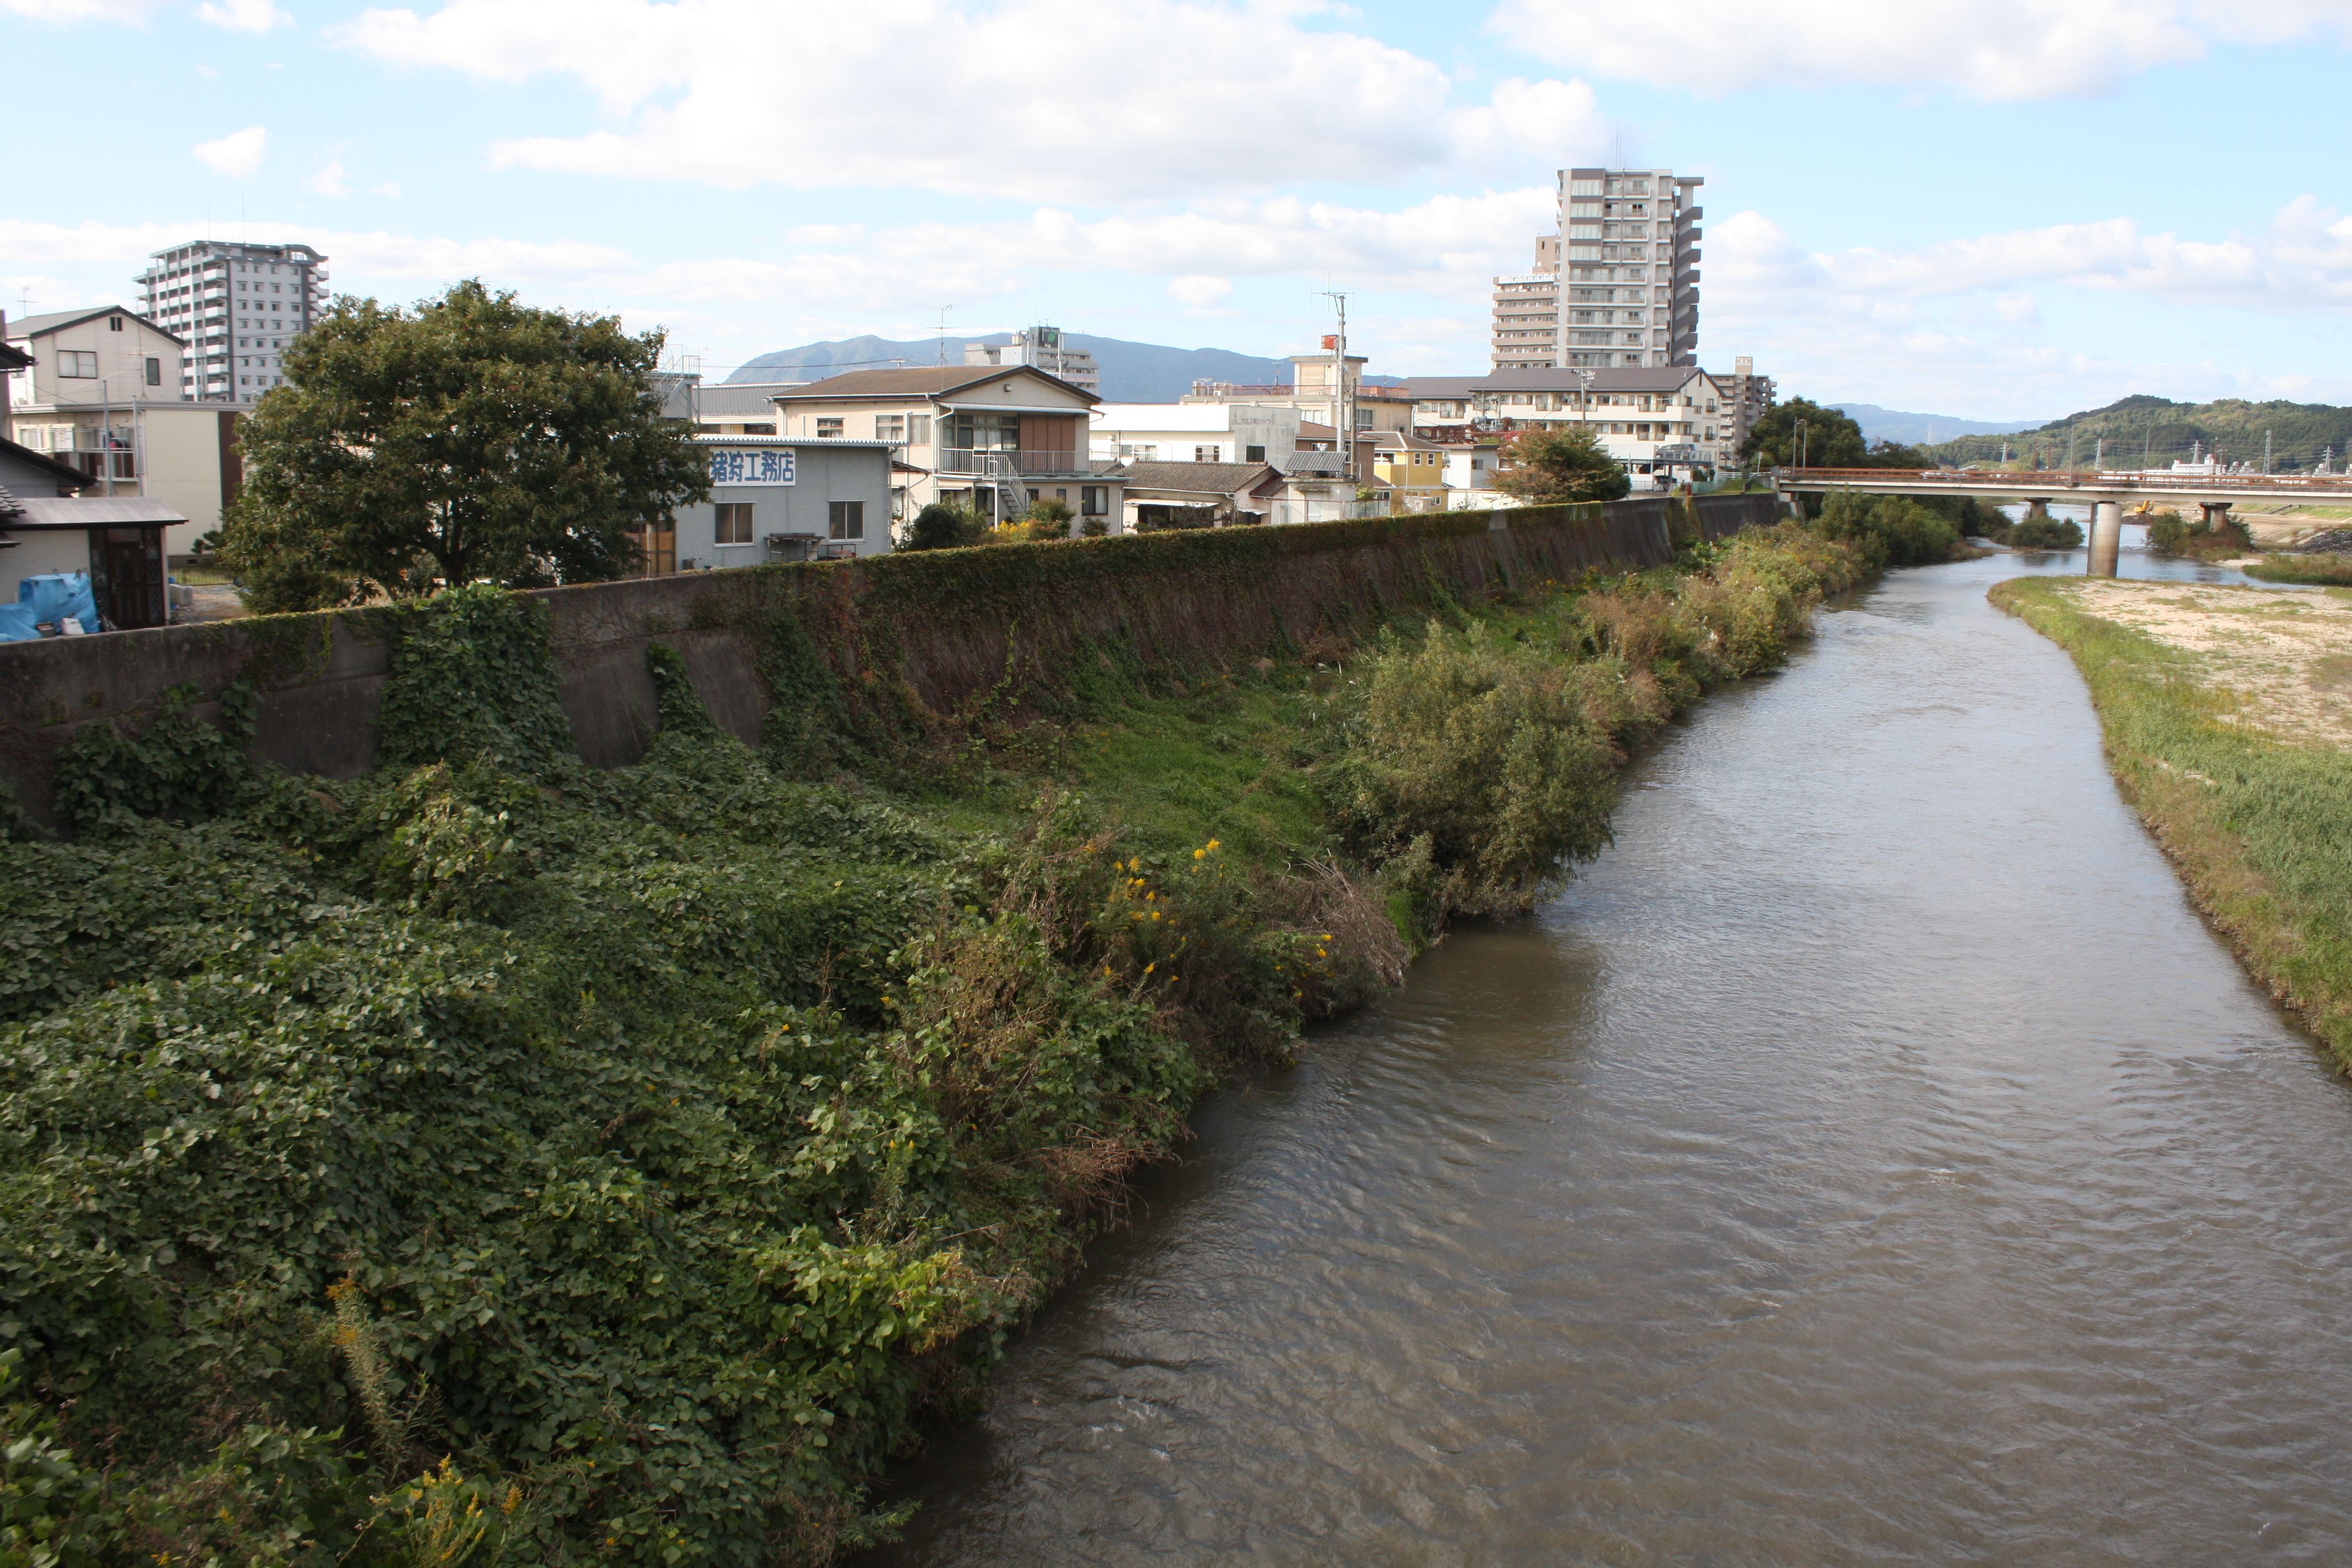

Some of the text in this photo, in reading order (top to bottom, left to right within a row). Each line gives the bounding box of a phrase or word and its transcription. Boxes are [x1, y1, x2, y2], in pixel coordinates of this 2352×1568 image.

[710, 450, 794, 482] 猪狩工務店
